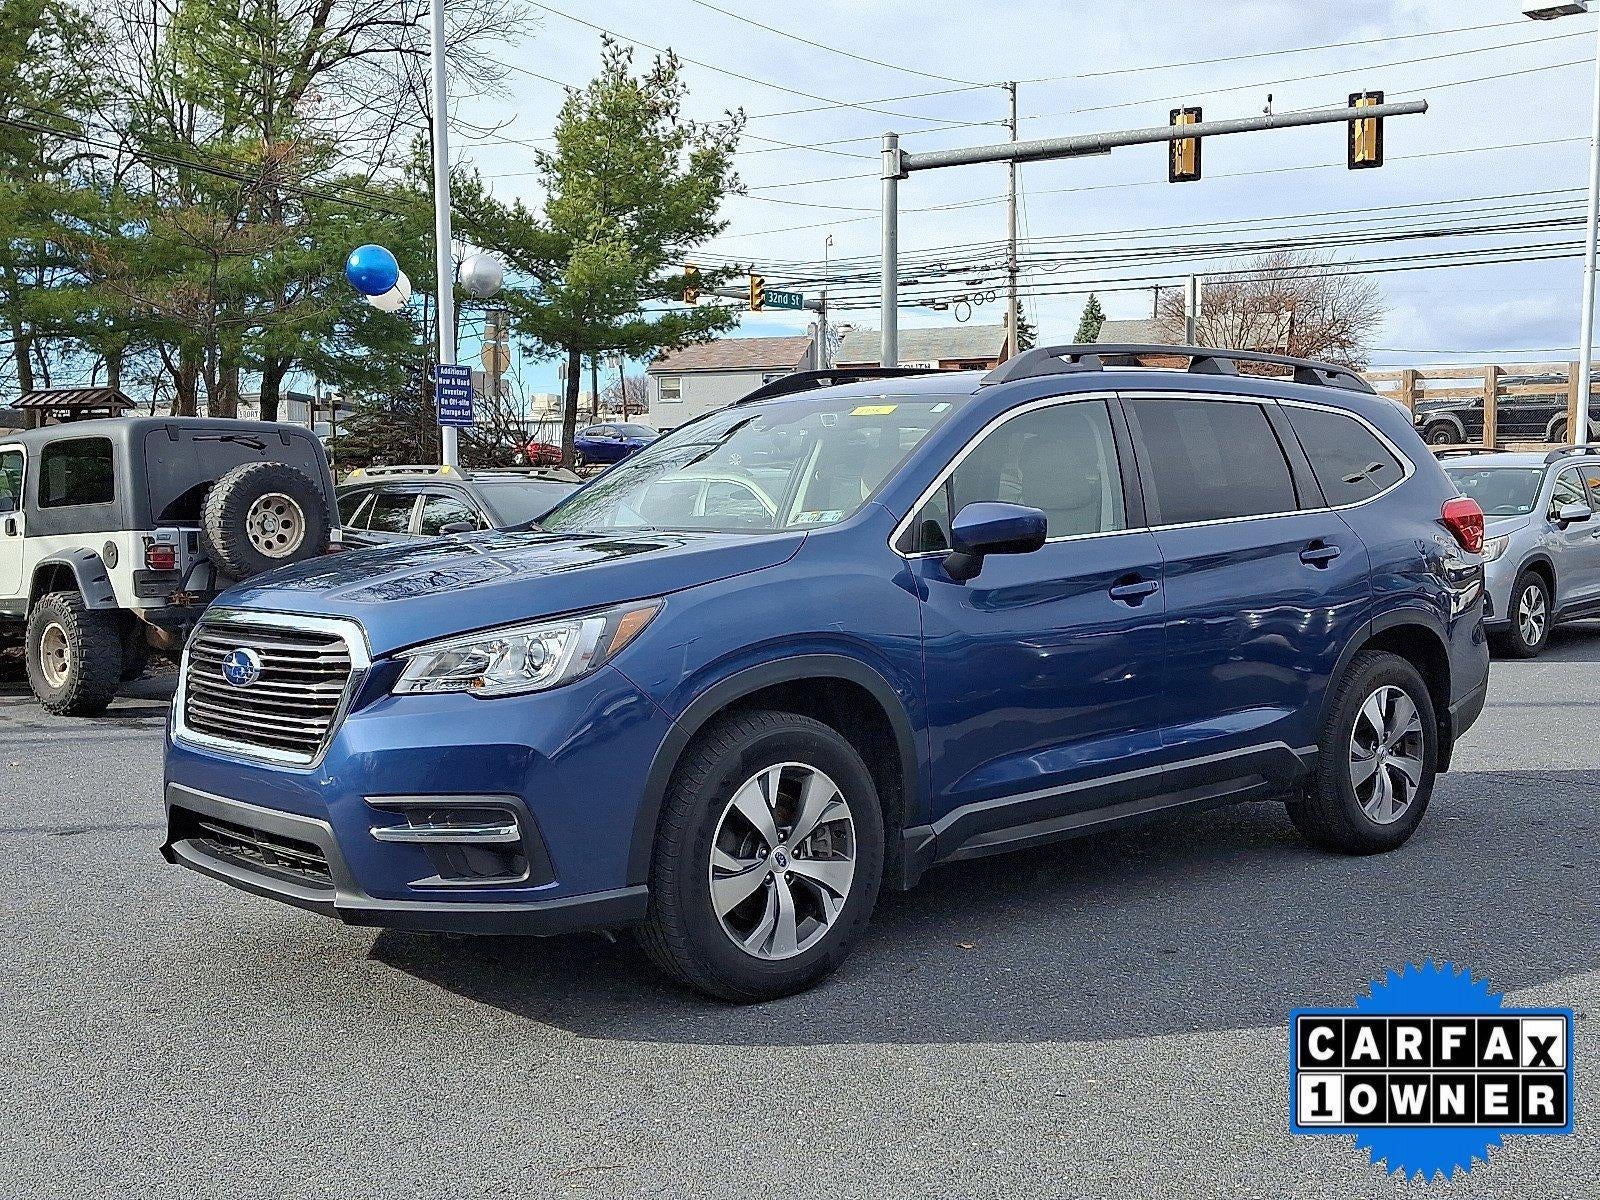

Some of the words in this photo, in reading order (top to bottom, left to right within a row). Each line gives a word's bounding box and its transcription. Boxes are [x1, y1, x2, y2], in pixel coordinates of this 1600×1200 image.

[768, 291, 788, 305] 32nd
[791, 294, 800, 306] St
[440, 367, 468, 376] Additional
[438, 377, 451, 385] New
[451, 378, 456, 386] &
[456, 378, 470, 387] Used
[442, 388, 468, 397] Inventory
[440, 408, 461, 417] Storage
[461, 409, 471, 417] Lot
